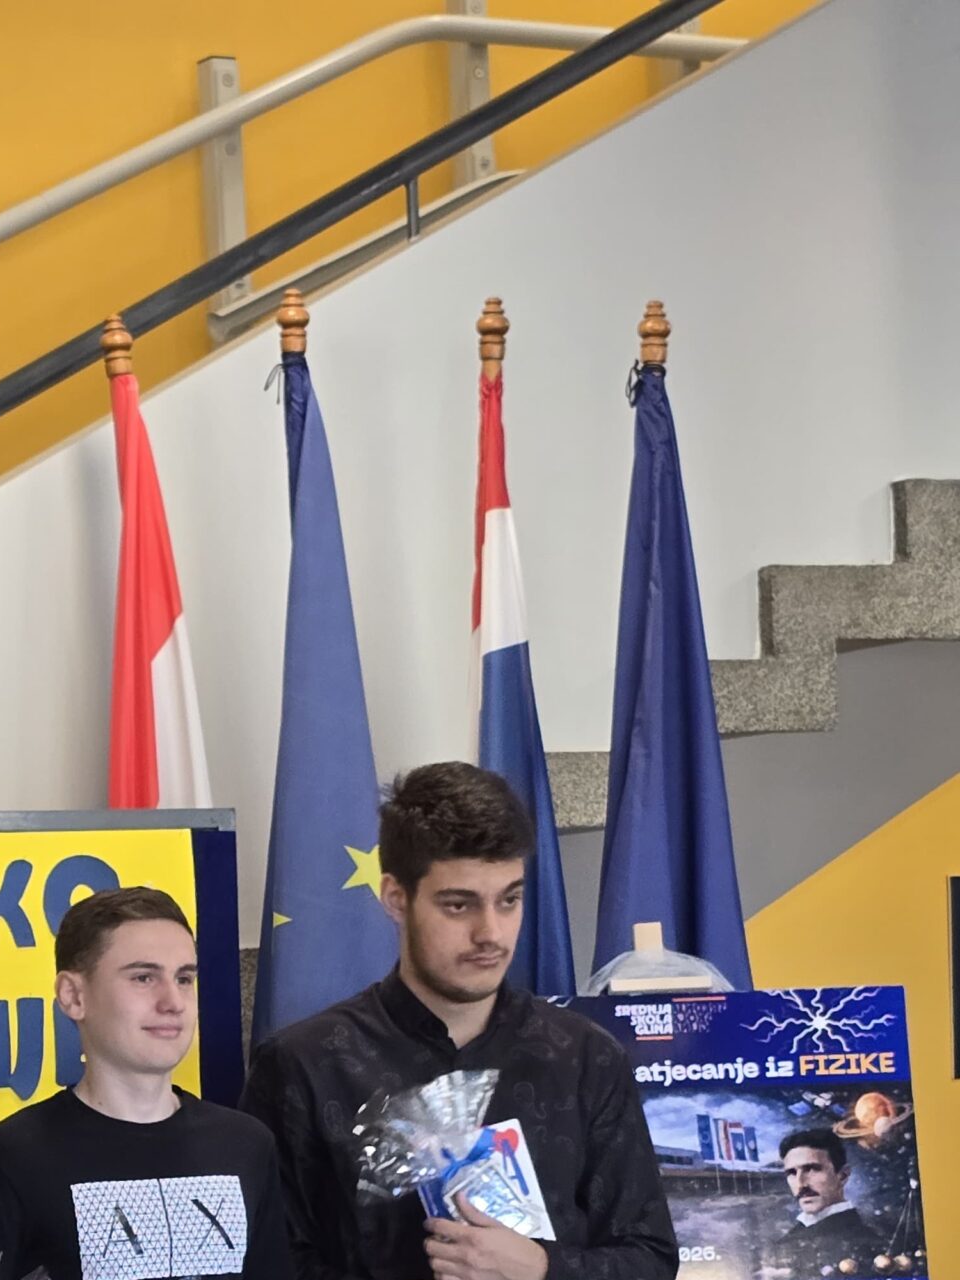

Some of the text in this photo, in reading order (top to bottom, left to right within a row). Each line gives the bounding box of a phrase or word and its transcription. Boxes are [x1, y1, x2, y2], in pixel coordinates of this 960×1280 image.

[633, 1052, 896, 1087] atjecanje iz FIZIKE
[678, 1246, 722, 1262] 026.
